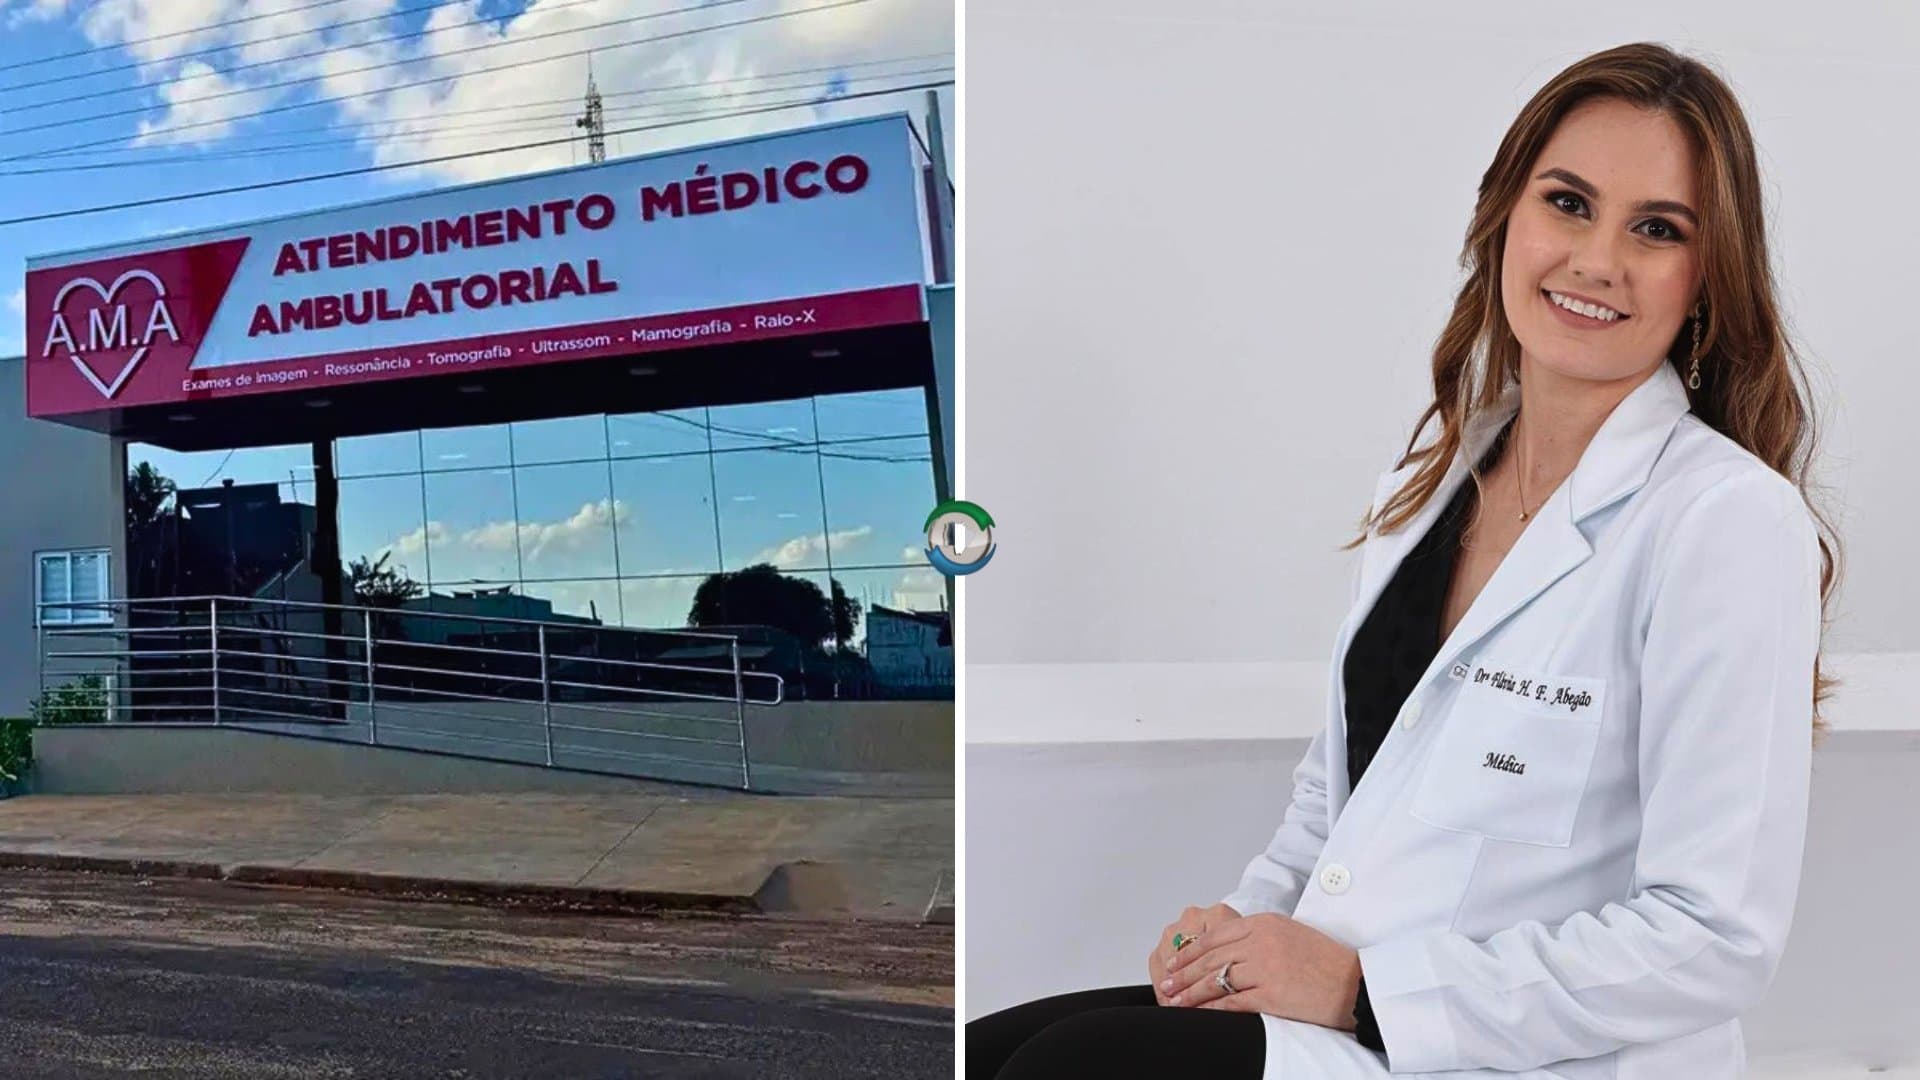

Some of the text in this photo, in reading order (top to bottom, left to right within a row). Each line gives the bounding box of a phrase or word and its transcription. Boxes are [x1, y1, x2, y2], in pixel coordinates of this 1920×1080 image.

[273, 155, 870, 276] ATENDIMENTO MÉDICO
[43, 299, 180, 357] A.M.A
[248, 259, 618, 337] AMBULATORIAL
[182, 377, 231, 392] Exames
[235, 374, 252, 386] de
[256, 368, 308, 385] Imagem
[325, 357, 410, 376] Ressonância
[428, 345, 511, 367] Tomografia
[531, 335, 610, 354] Ultrassom
[632, 319, 732, 342] Mamografia
[1482, 751, 1526, 775] Médica
